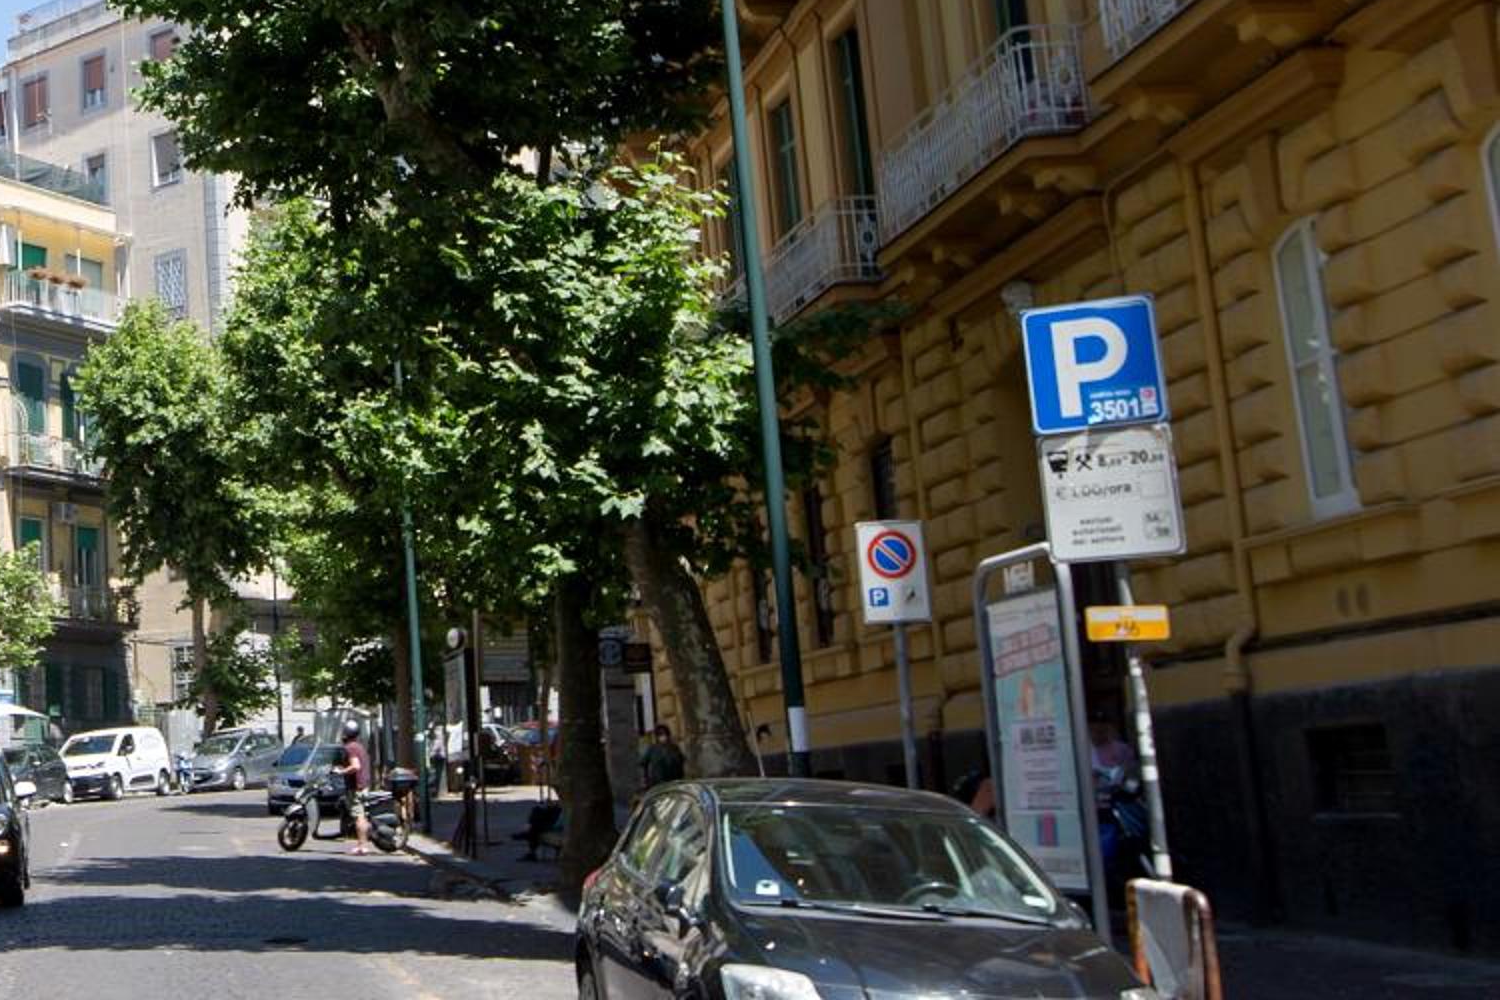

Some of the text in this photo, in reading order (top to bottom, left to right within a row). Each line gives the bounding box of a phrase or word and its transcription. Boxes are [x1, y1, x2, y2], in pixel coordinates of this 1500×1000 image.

[1050, 317, 1128, 419] P
[1089, 398, 1140, 423] 3501
[873, 589, 885, 606] P
